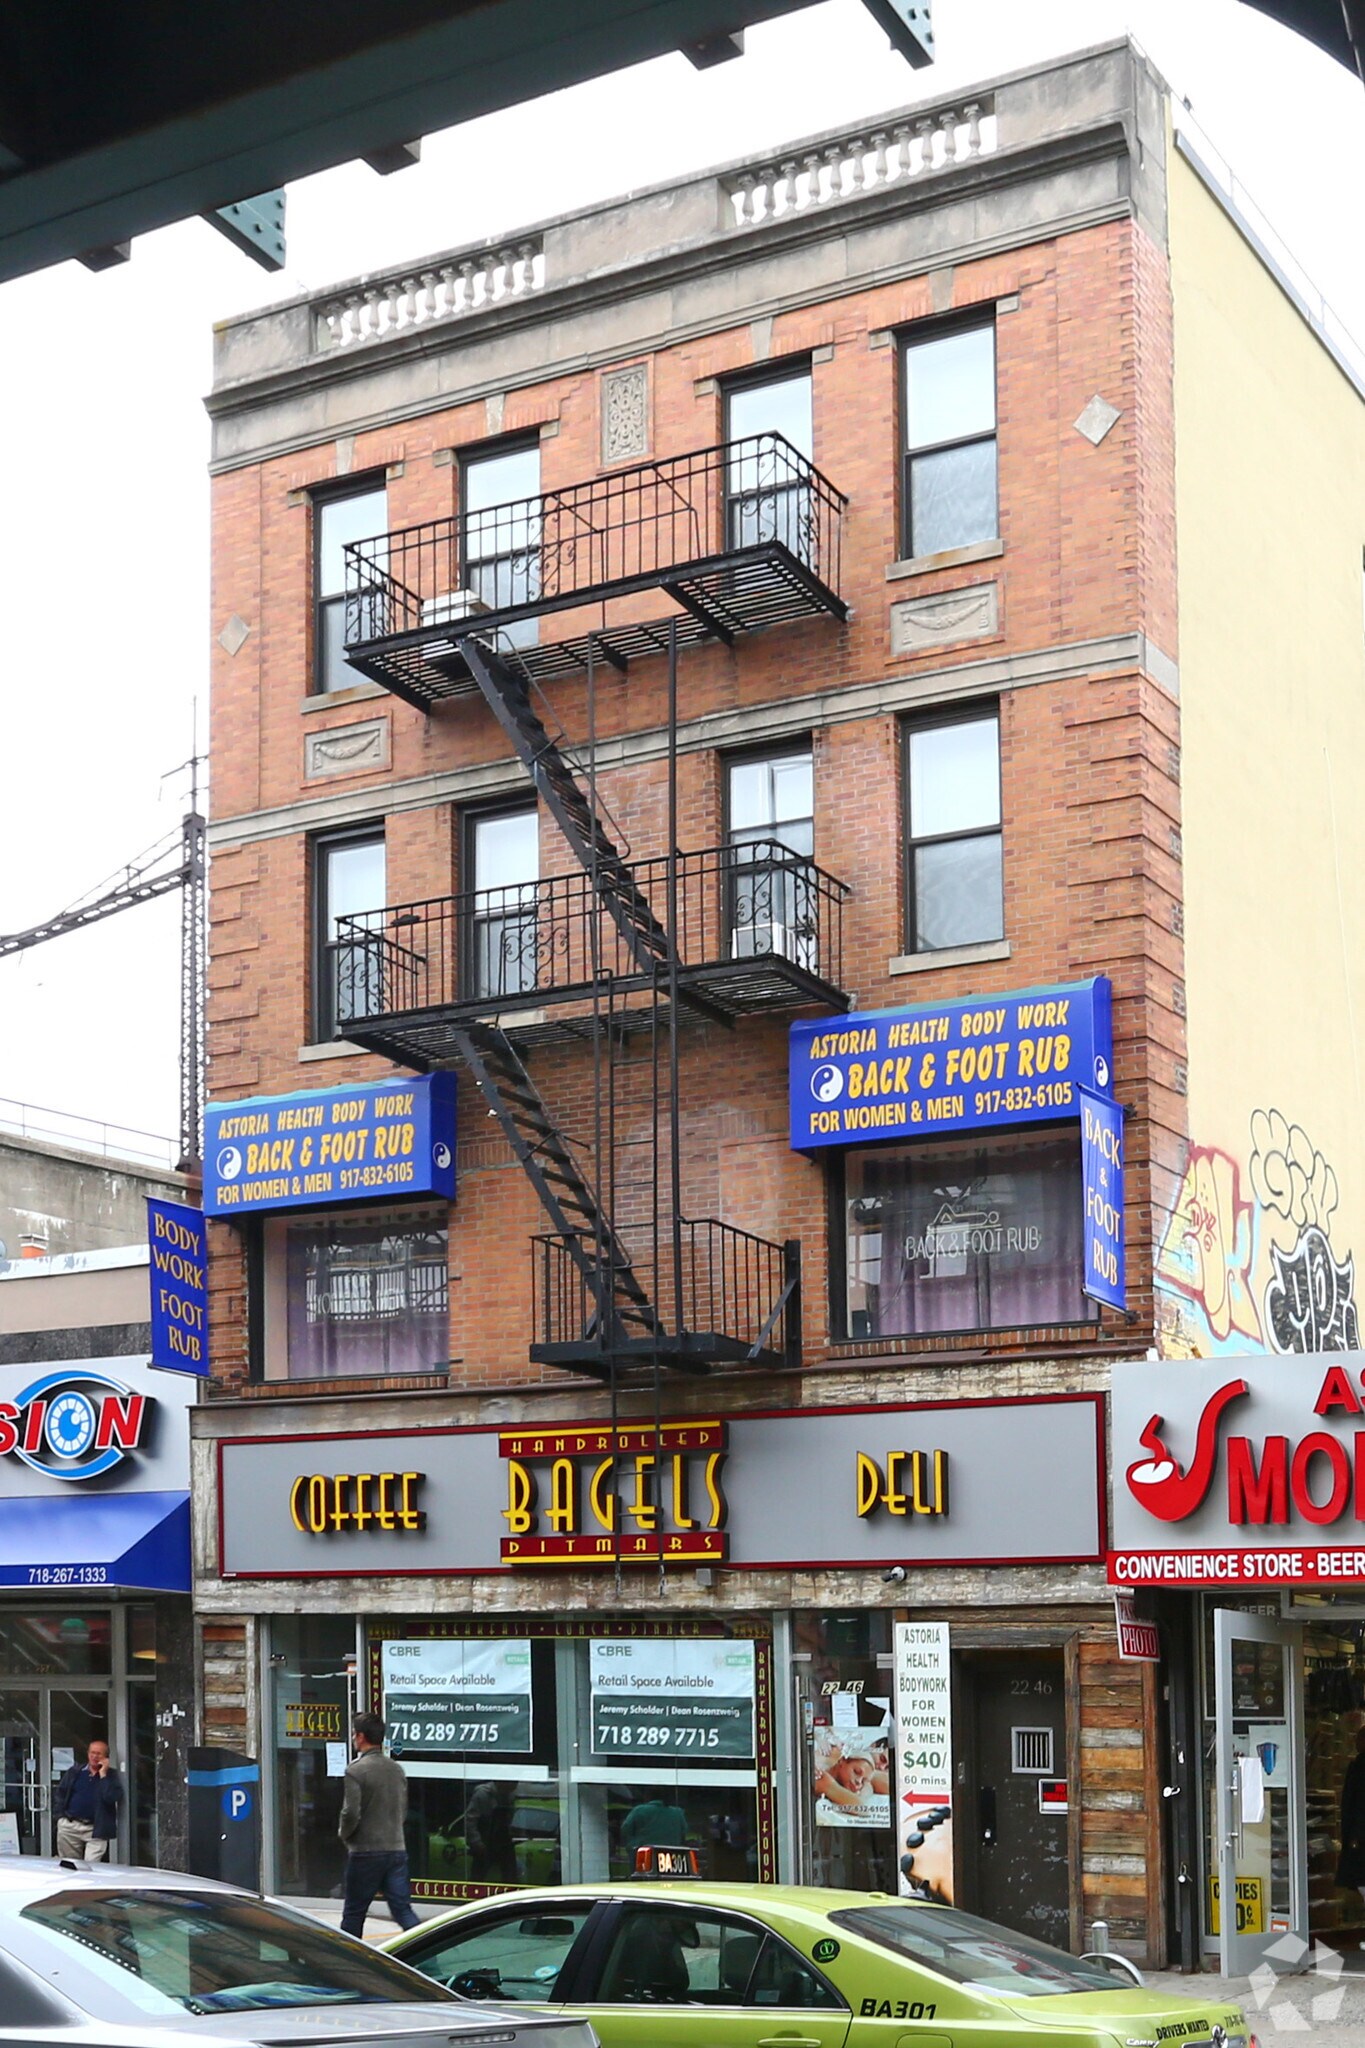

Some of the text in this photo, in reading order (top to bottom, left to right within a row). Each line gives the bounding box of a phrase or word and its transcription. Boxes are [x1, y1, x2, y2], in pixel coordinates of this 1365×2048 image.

[810, 1000, 1070, 1059] ASTORIA HEALTH BODY WORK
[847, 1034, 1071, 1099] BACK & FOOT RUB
[218, 1093, 414, 1140] ASTORIA HEALTH BODY WORK
[810, 1081, 1072, 1134] FOR WOMEN & MEN 917-832-6105
[246, 1122, 415, 1175] BACK & FOOT RUB
[1084, 1107, 1121, 1169] BACK
[217, 1162, 413, 1205] FOR WOMEN & MEN 917-832-6105
[1099, 1167, 1108, 1187] &
[1087, 1186, 1120, 1243] FOOT
[153, 1212, 200, 1256] BODY
[905, 1233, 946, 1260] BACK
[963, 1228, 1003, 1256] FOOT
[1007, 1225, 1041, 1251] RUB
[153, 1245, 204, 1290] WORK
[1093, 1238, 1118, 1287] RUB
[160, 1289, 203, 1331] FOOT
[168, 1325, 201, 1361] RUB
[1313, 1365, 1365, 1415] A
[510, 1431, 710, 1454] HANDROLLED
[501, 1452, 721, 1534] BAGELS
[856, 1448, 943, 1518] DELI
[289, 1471, 418, 1533] COFFEE
[509, 1535, 712, 1555] DITMARS
[28, 1567, 107, 1584] 718-267-1333
[1115, 1554, 1239, 1579] CONVENIENCE
[1243, 1553, 1303, 1577] STORE
[556, 1622, 610, 1636] LUNCH
[630, 1622, 700, 1635] DINNER
[904, 1628, 941, 1644] ASTORIA
[389, 1646, 421, 1657] CBRE
[597, 1646, 633, 1657] CBRE
[1121, 1627, 1157, 1655] PHOTO
[906, 1653, 940, 1668] HEALTH
[390, 1674, 496, 1688] Retail Space Available
[598, 1674, 714, 1689] Retail Space Available
[823, 1681, 862, 1694] 22 46
[899, 1677, 947, 1693] BODYWORK
[1011, 1679, 1053, 1695] 22 46
[455, 1703, 475, 1712] Dean
[599, 1705, 628, 1716] Jeremy
[671, 1706, 692, 1716] Dean
[693, 1706, 740, 1718] Rosenzweig
[912, 1699, 935, 1711] FOR
[286, 1711, 340, 1733] BAGELS
[389, 1722, 499, 1742] 718 289 7715
[901, 1716, 946, 1727] WOMEN
[598, 1725, 719, 1747] 718 289 7715
[907, 1733, 945, 1744] & MEN
[758, 1651, 771, 1883] BAKERY HOT FOOD
[903, 1751, 947, 1770] $40/
[904, 1775, 947, 1785] 60 mins
[231, 1789, 246, 1817] P
[657, 1852, 688, 1874] BA301
[415, 1882, 468, 1898] COFFEE
[859, 1997, 937, 2020] BA301
[1155, 2022, 1187, 2041] DRIVERS
[1186, 2019, 1210, 2034] WANTED
